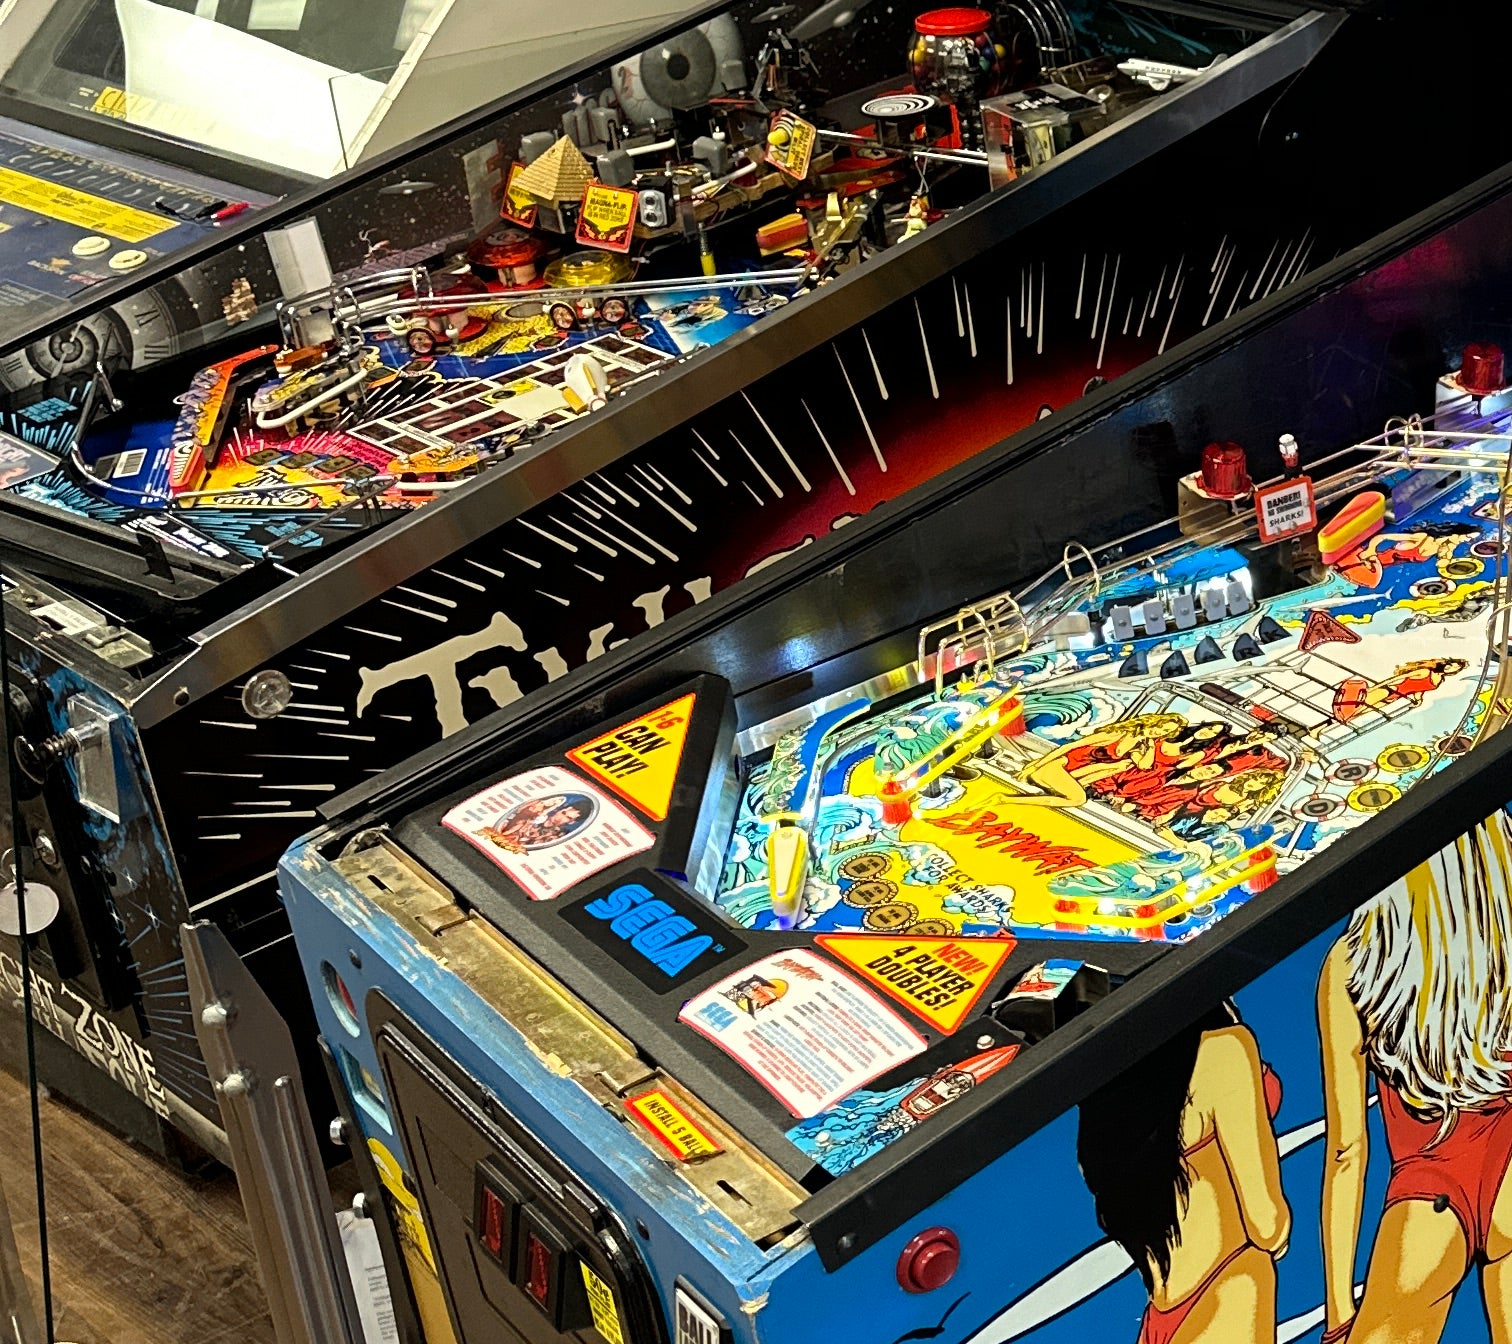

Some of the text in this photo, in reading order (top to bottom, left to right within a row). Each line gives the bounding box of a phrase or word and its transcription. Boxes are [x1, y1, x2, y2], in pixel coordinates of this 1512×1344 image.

[1269, 510, 1304, 528] SHARKS!
[647, 710, 685, 730] 1-6
[614, 725, 672, 755] CAN
[582, 741, 649, 779] PLAY!
[924, 865, 949, 883] FOR
[929, 853, 974, 886] COLLECT
[584, 883, 714, 978] SEGA
[893, 945, 976, 996] 4 PLAYER
[930, 942, 989, 977] NEW!
[865, 955, 958, 1011] DOUBLES!
[61, 982, 166, 1101] ZONE
[644, 1098, 678, 1129] INSTALL
